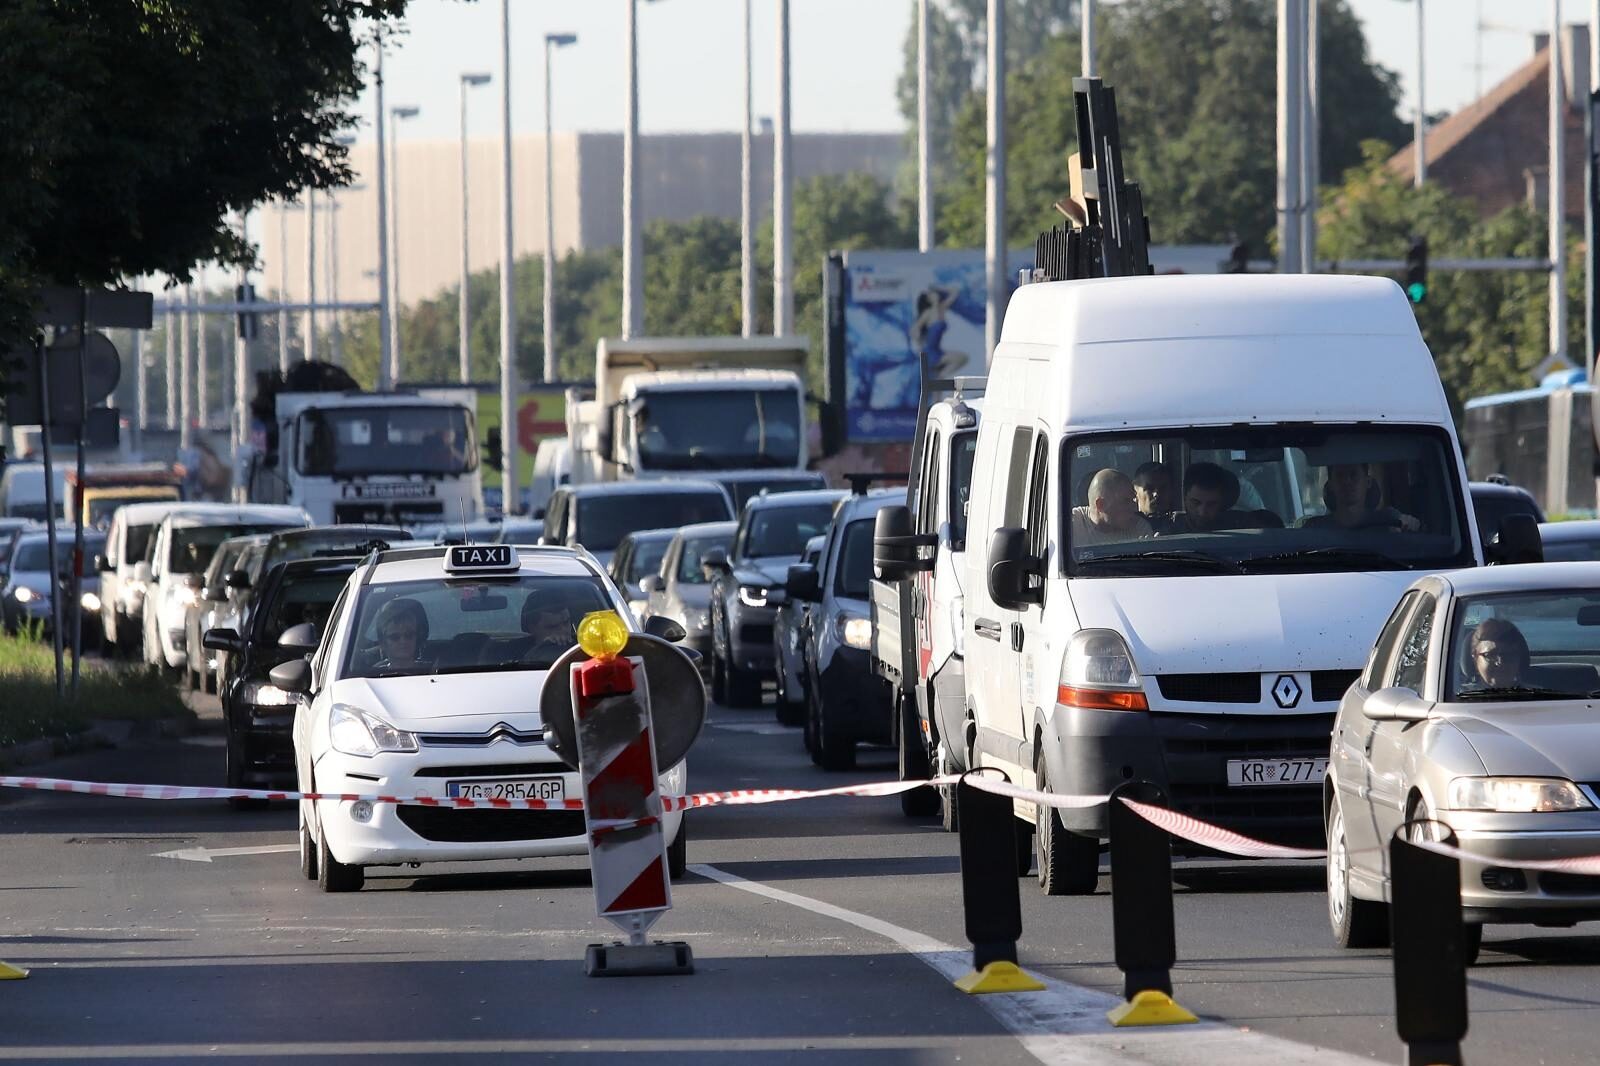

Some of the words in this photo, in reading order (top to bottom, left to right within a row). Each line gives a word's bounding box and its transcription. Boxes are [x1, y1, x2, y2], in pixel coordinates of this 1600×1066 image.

[458, 549, 505, 562] TAXI
[1241, 763, 1264, 782] KR
[1279, 761, 1329, 781] 277-
